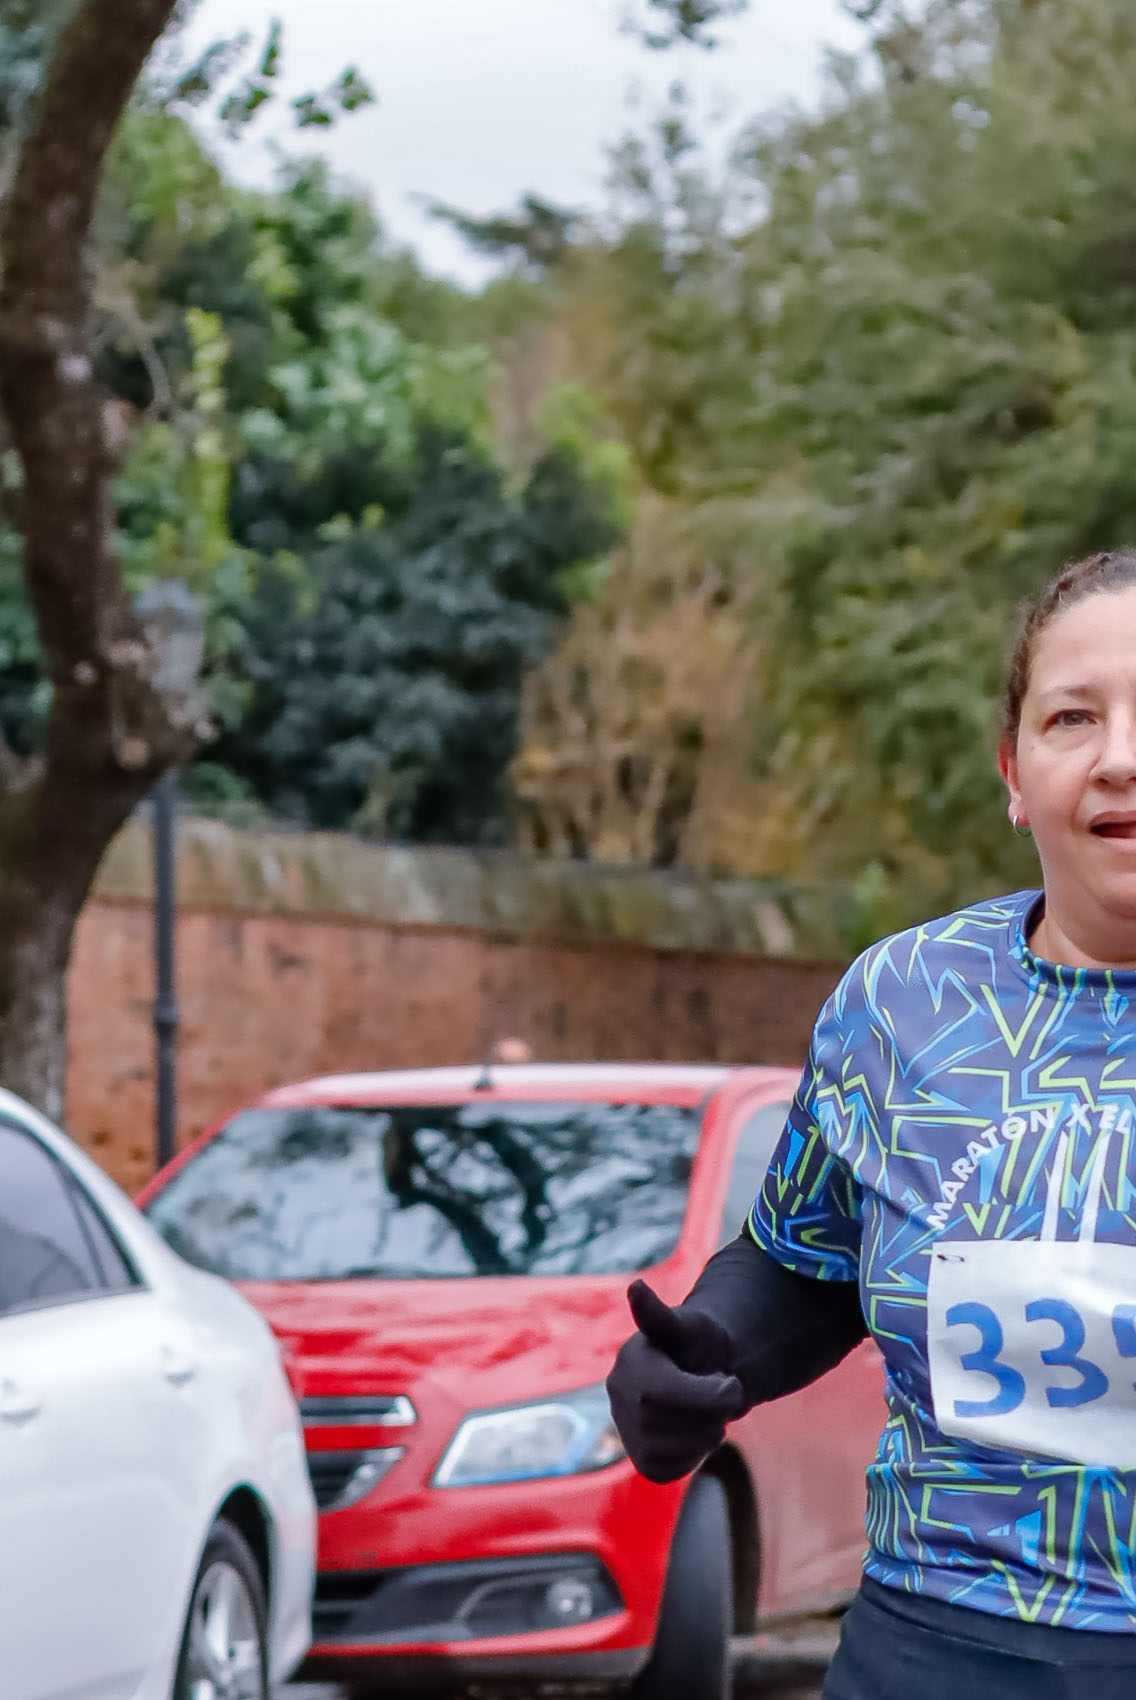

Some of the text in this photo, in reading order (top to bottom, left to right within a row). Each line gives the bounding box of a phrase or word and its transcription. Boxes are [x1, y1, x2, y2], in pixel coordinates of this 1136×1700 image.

[926, 1107, 1056, 1230] MARATÓN
[1066, 1103, 1090, 1128] X
[1099, 1104, 1131, 1135] EL
